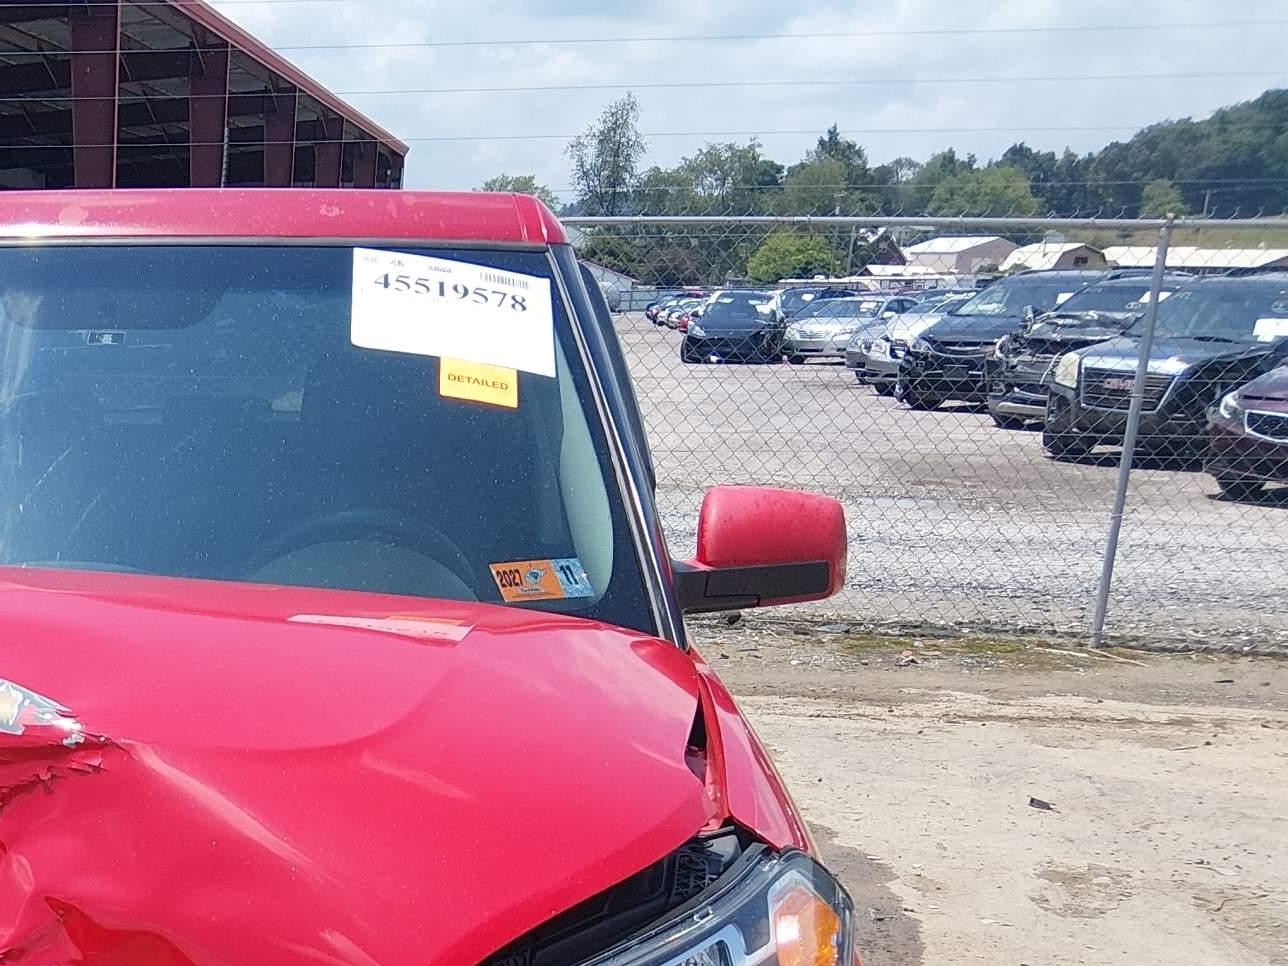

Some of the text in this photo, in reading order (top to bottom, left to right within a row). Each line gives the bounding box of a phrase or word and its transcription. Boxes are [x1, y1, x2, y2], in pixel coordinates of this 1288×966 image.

[374, 272, 528, 313] 45519578
[447, 372, 509, 391] DETAILED
[496, 564, 580, 589] 2027 11
